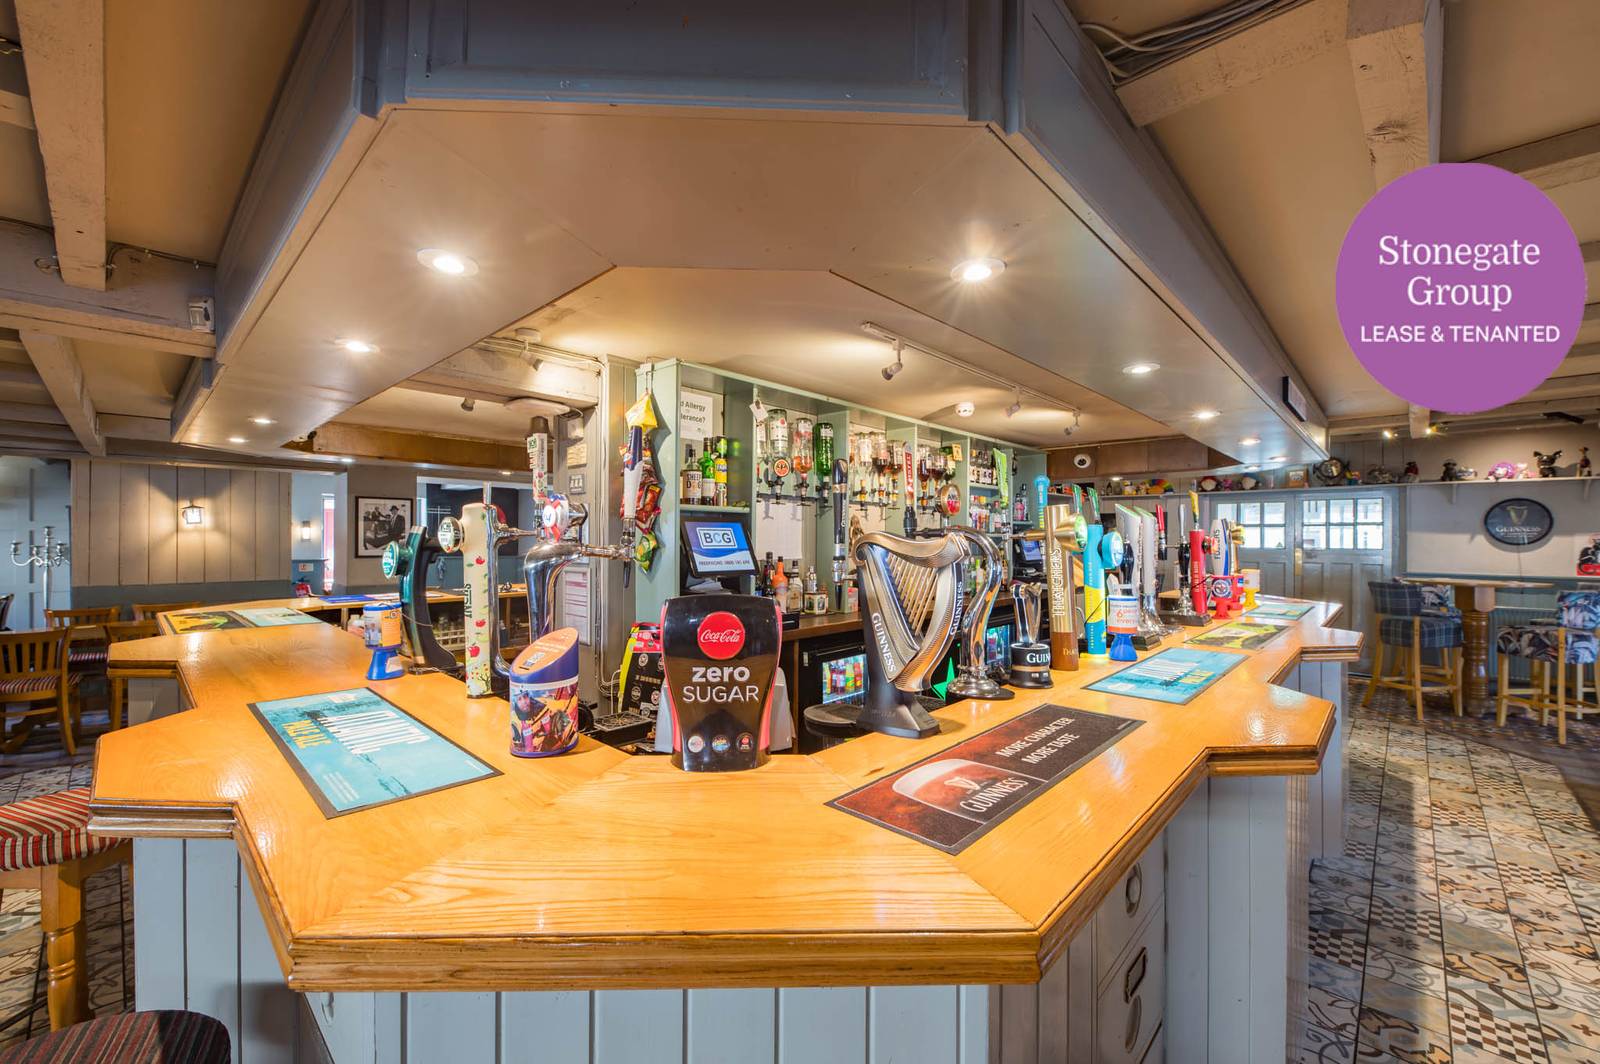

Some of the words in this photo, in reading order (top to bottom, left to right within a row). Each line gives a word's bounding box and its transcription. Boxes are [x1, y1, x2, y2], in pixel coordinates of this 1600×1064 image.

[685, 401, 706, 412] Allergy
[703, 532, 732, 544] BCG
[1050, 547, 1065, 617] THATCHERS
[948, 581, 963, 636] GUINNESS
[700, 629, 742, 644] Coca-Cola
[871, 612, 897, 672] GUINNESS
[691, 667, 750, 682] zero
[682, 685, 759, 702] SUGAR
[994, 739, 1033, 758] MORE
[1023, 716, 1076, 743] CHARACTER
[1020, 745, 1059, 764] MORE
[1052, 732, 1081, 749] TASTE
[959, 776, 1030, 813] GUINNESS
